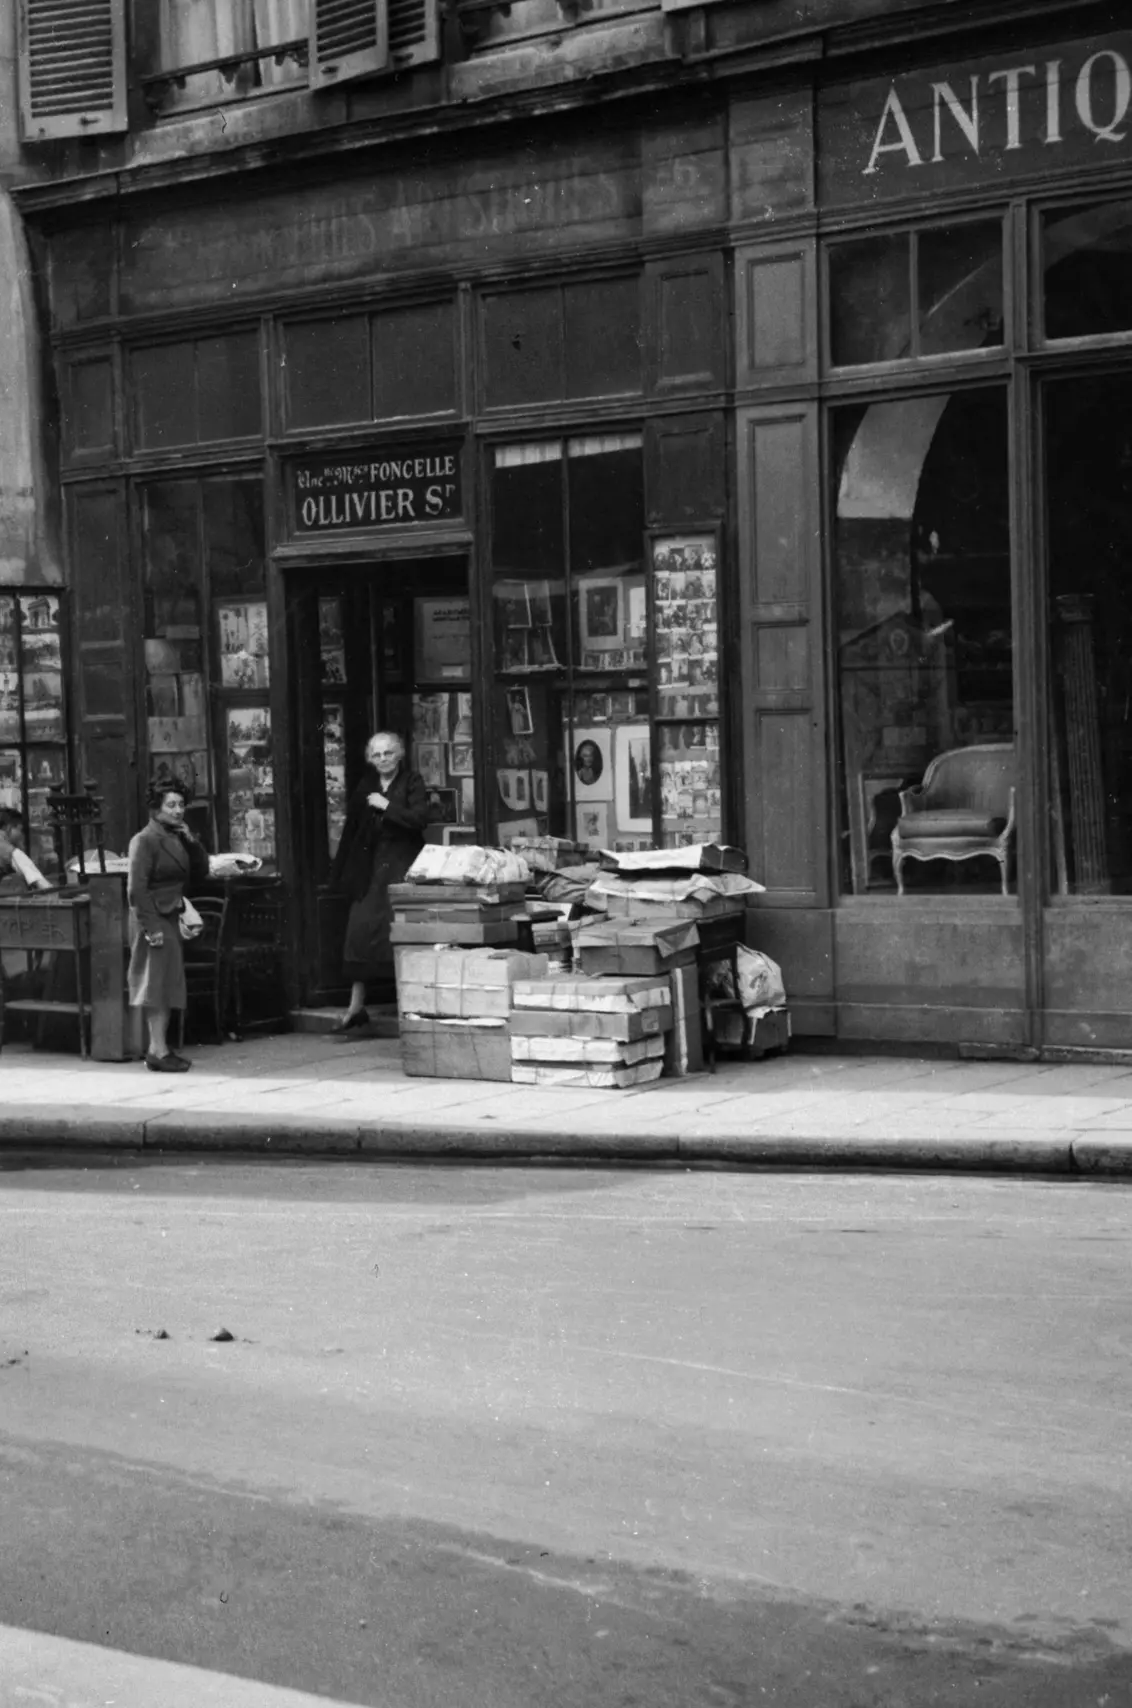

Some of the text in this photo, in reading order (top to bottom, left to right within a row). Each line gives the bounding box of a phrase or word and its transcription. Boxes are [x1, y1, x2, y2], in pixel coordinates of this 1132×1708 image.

[861, 49, 1131, 175] ANTIQ
[370, 455, 456, 483] FONCELLE
[302, 487, 415, 526] OLLIVIER
